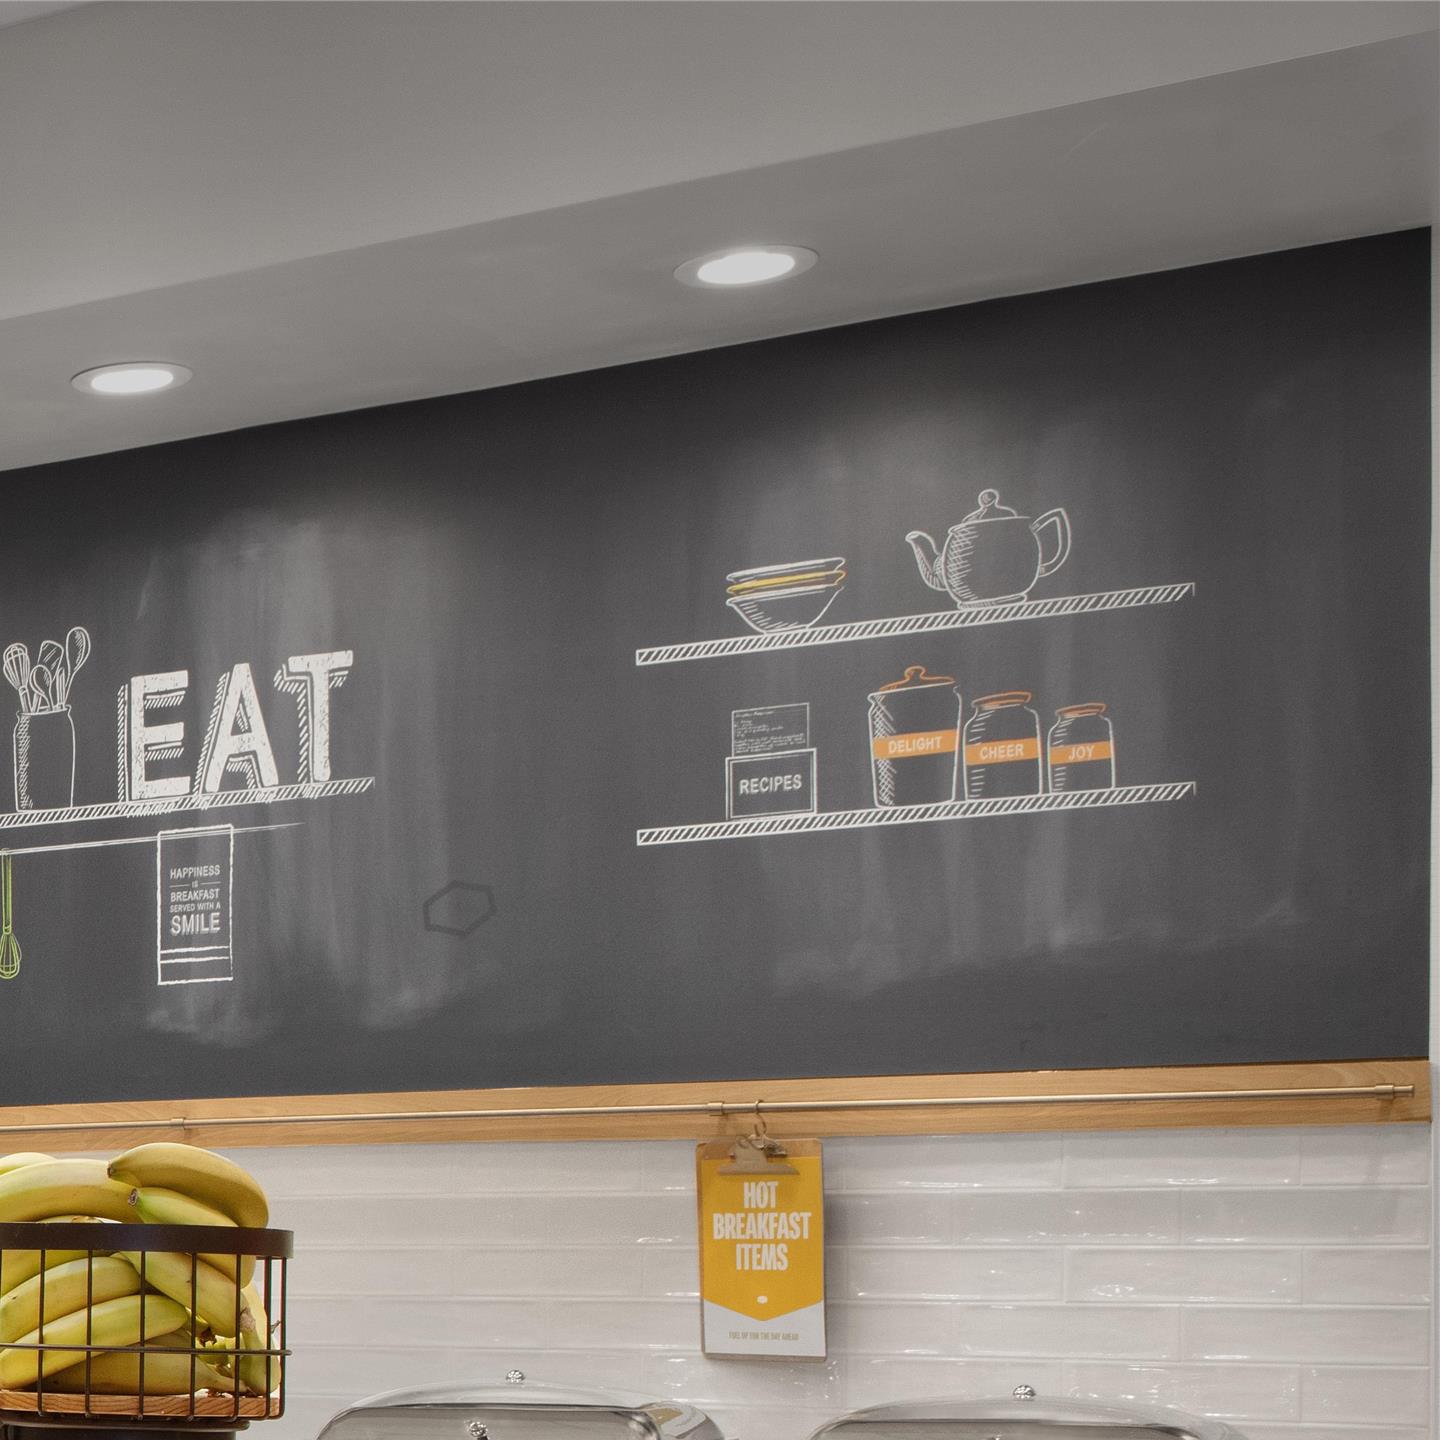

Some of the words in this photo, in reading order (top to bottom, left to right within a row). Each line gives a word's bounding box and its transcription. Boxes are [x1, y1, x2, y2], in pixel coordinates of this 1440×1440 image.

[120, 649, 354, 801] EAT
[888, 736, 944, 754] DELIGHT
[979, 744, 1025, 760] CHEER
[1068, 746, 1095, 760] JOY
[740, 774, 802, 795] RECIPES
[169, 864, 221, 880] HAPPINESS
[170, 888, 221, 903] BREAKFAST
[169, 903, 196, 913] SERVED
[196, 902, 215, 911] WITH
[215, 902, 221, 910] A
[170, 912, 221, 936] SMILE
[743, 1181, 779, 1209] HOT
[713, 1212, 811, 1240] BREAKFAST
[736, 1243, 789, 1271] ITEMS
